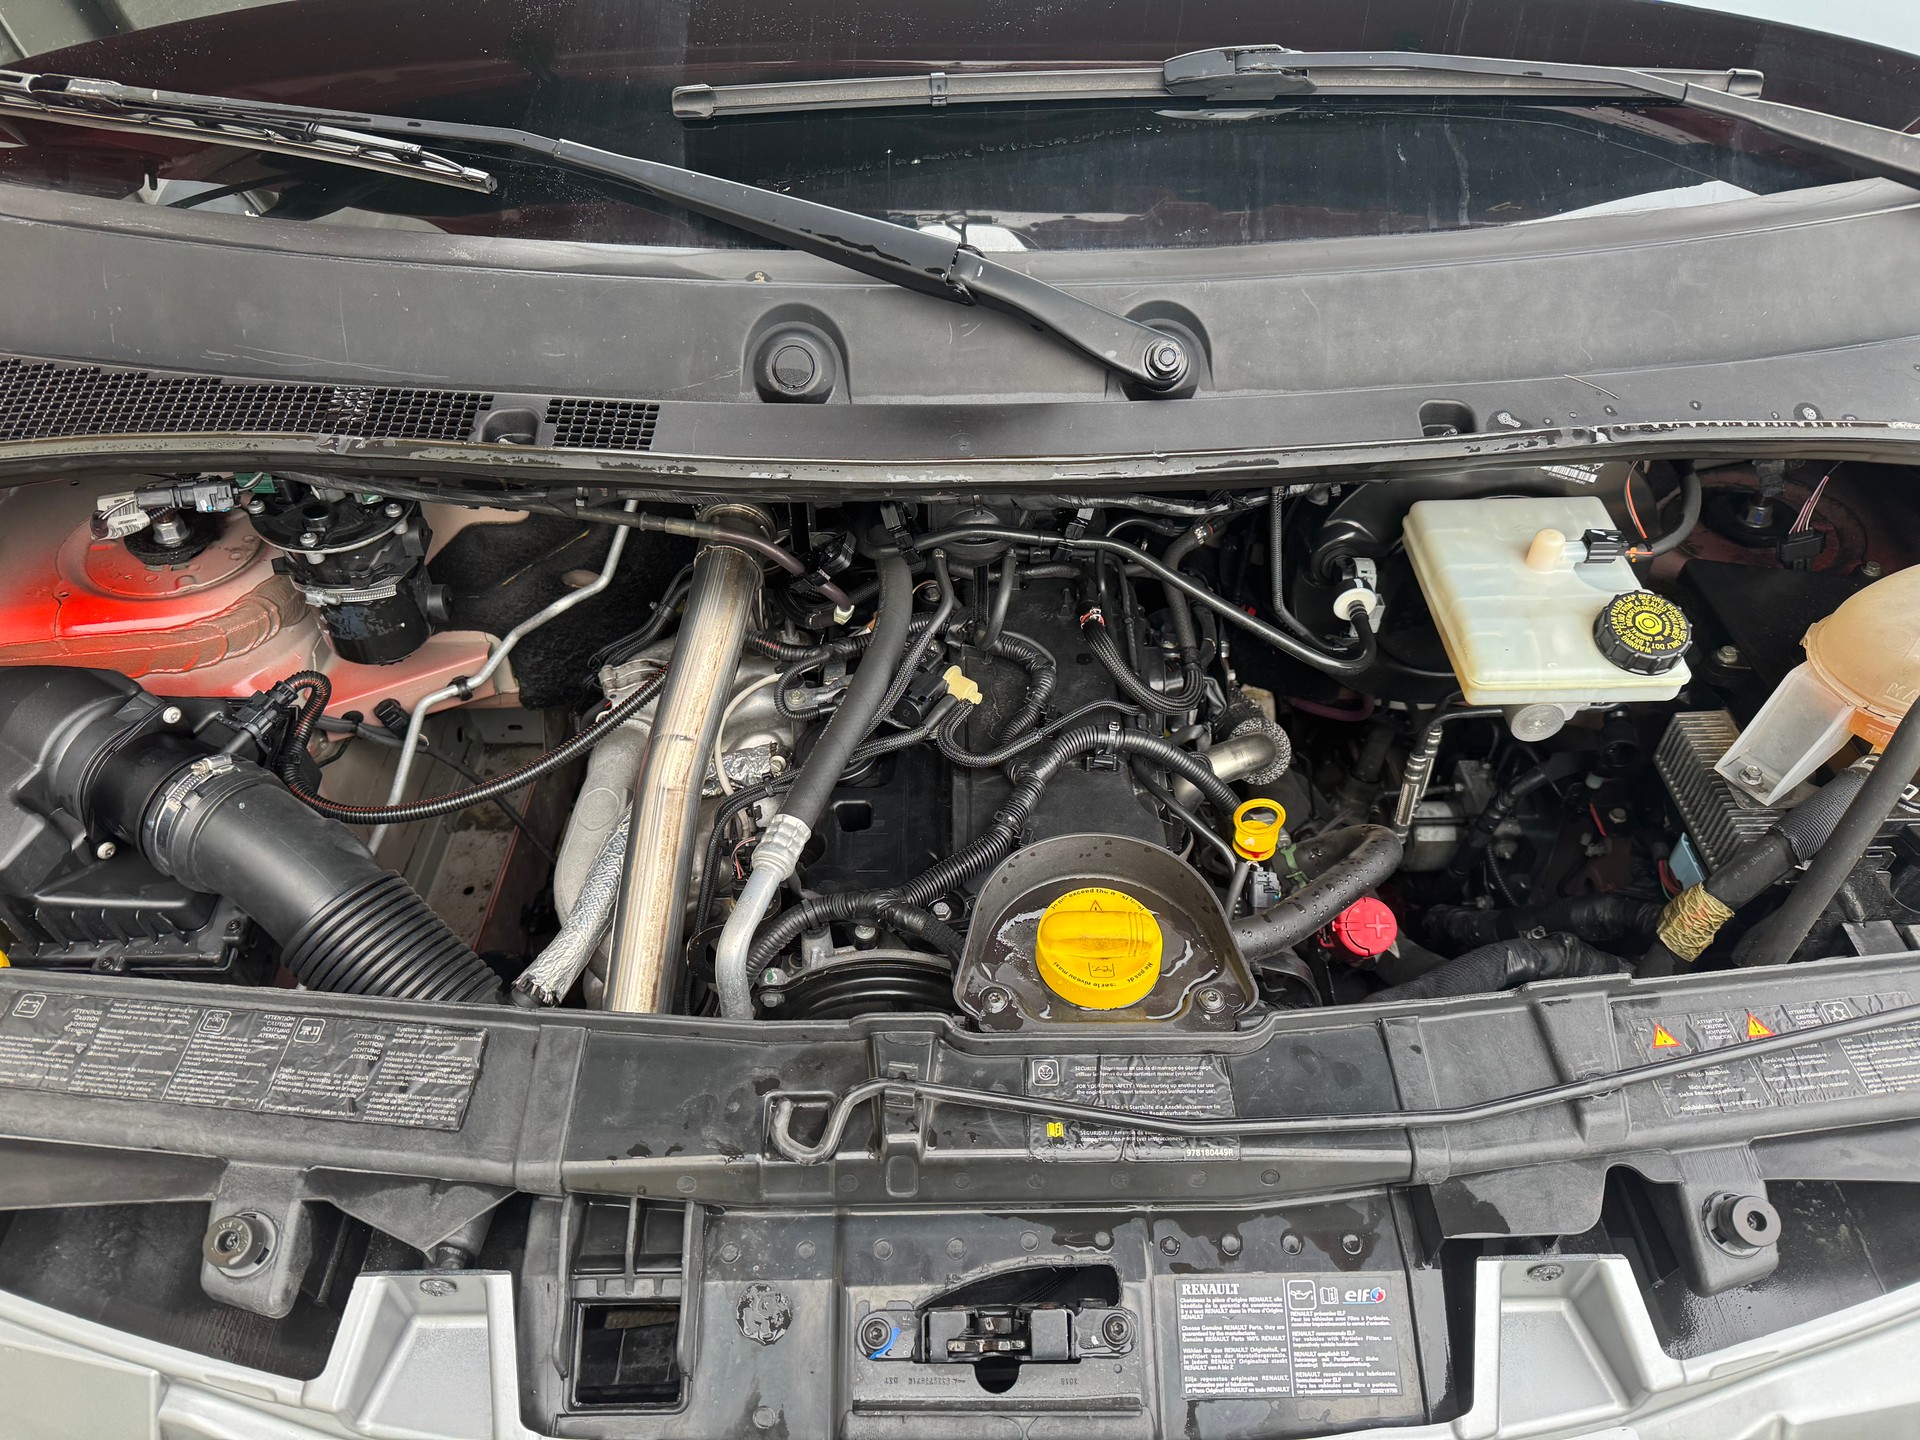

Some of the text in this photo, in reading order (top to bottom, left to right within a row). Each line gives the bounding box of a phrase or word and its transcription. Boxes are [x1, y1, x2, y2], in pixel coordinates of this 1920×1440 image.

[1638, 594, 1665, 604] BEFORE
[1611, 600, 1625, 615] FILLER
[1620, 602, 1634, 613] FROM
[1641, 600, 1667, 611] SEALED
[1618, 614, 1627, 628] FLUID
[1666, 603, 1687, 630] REMOVING
[1611, 616, 1622, 635] CLEAN
[1666, 612, 1680, 639] CONTAINER
[1623, 629, 1644, 644] BRAKE
[1679, 630, 1687, 642] USE
[1621, 636, 1652, 653] WARNING
[1667, 640, 1681, 649] ONLY
[1069, 889, 1094, 897] exceed
[1053, 962, 1068, 975] maxi
[1144, 962, 1153, 971] Ne
[1135, 969, 1145, 978] pas
[1069, 974, 1091, 986] niveau
[357, 1040, 384, 1048] CAUTION
[1182, 1284, 1239, 1294] RENAULT
[1345, 1289, 1370, 1301] elf
